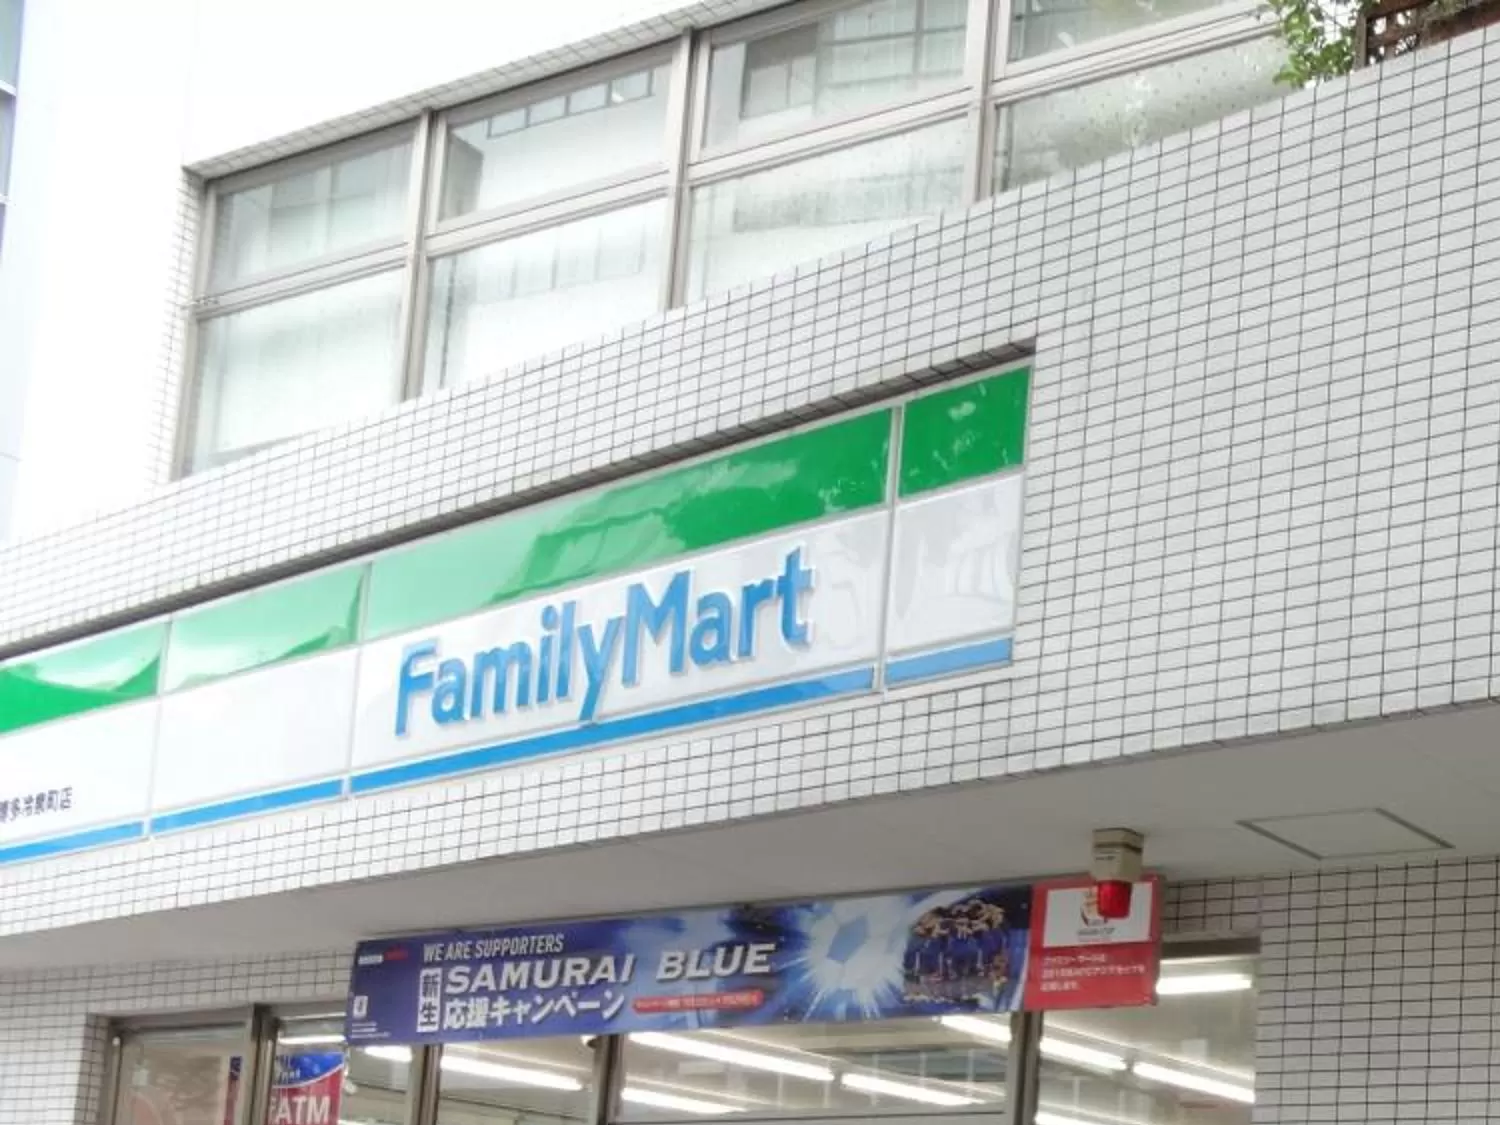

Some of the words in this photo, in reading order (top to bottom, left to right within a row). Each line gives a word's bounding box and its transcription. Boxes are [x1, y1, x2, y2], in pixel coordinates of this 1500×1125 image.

[395, 546, 814, 736] FamilyMart
[423, 943, 444, 962] WE
[445, 940, 472, 960] ARE
[475, 933, 564, 958] SUPPORTERS
[445, 954, 635, 994] SAMURAI
[656, 943, 776, 980] BLUE
[443, 990, 625, 1031] 応援キャンペーン
